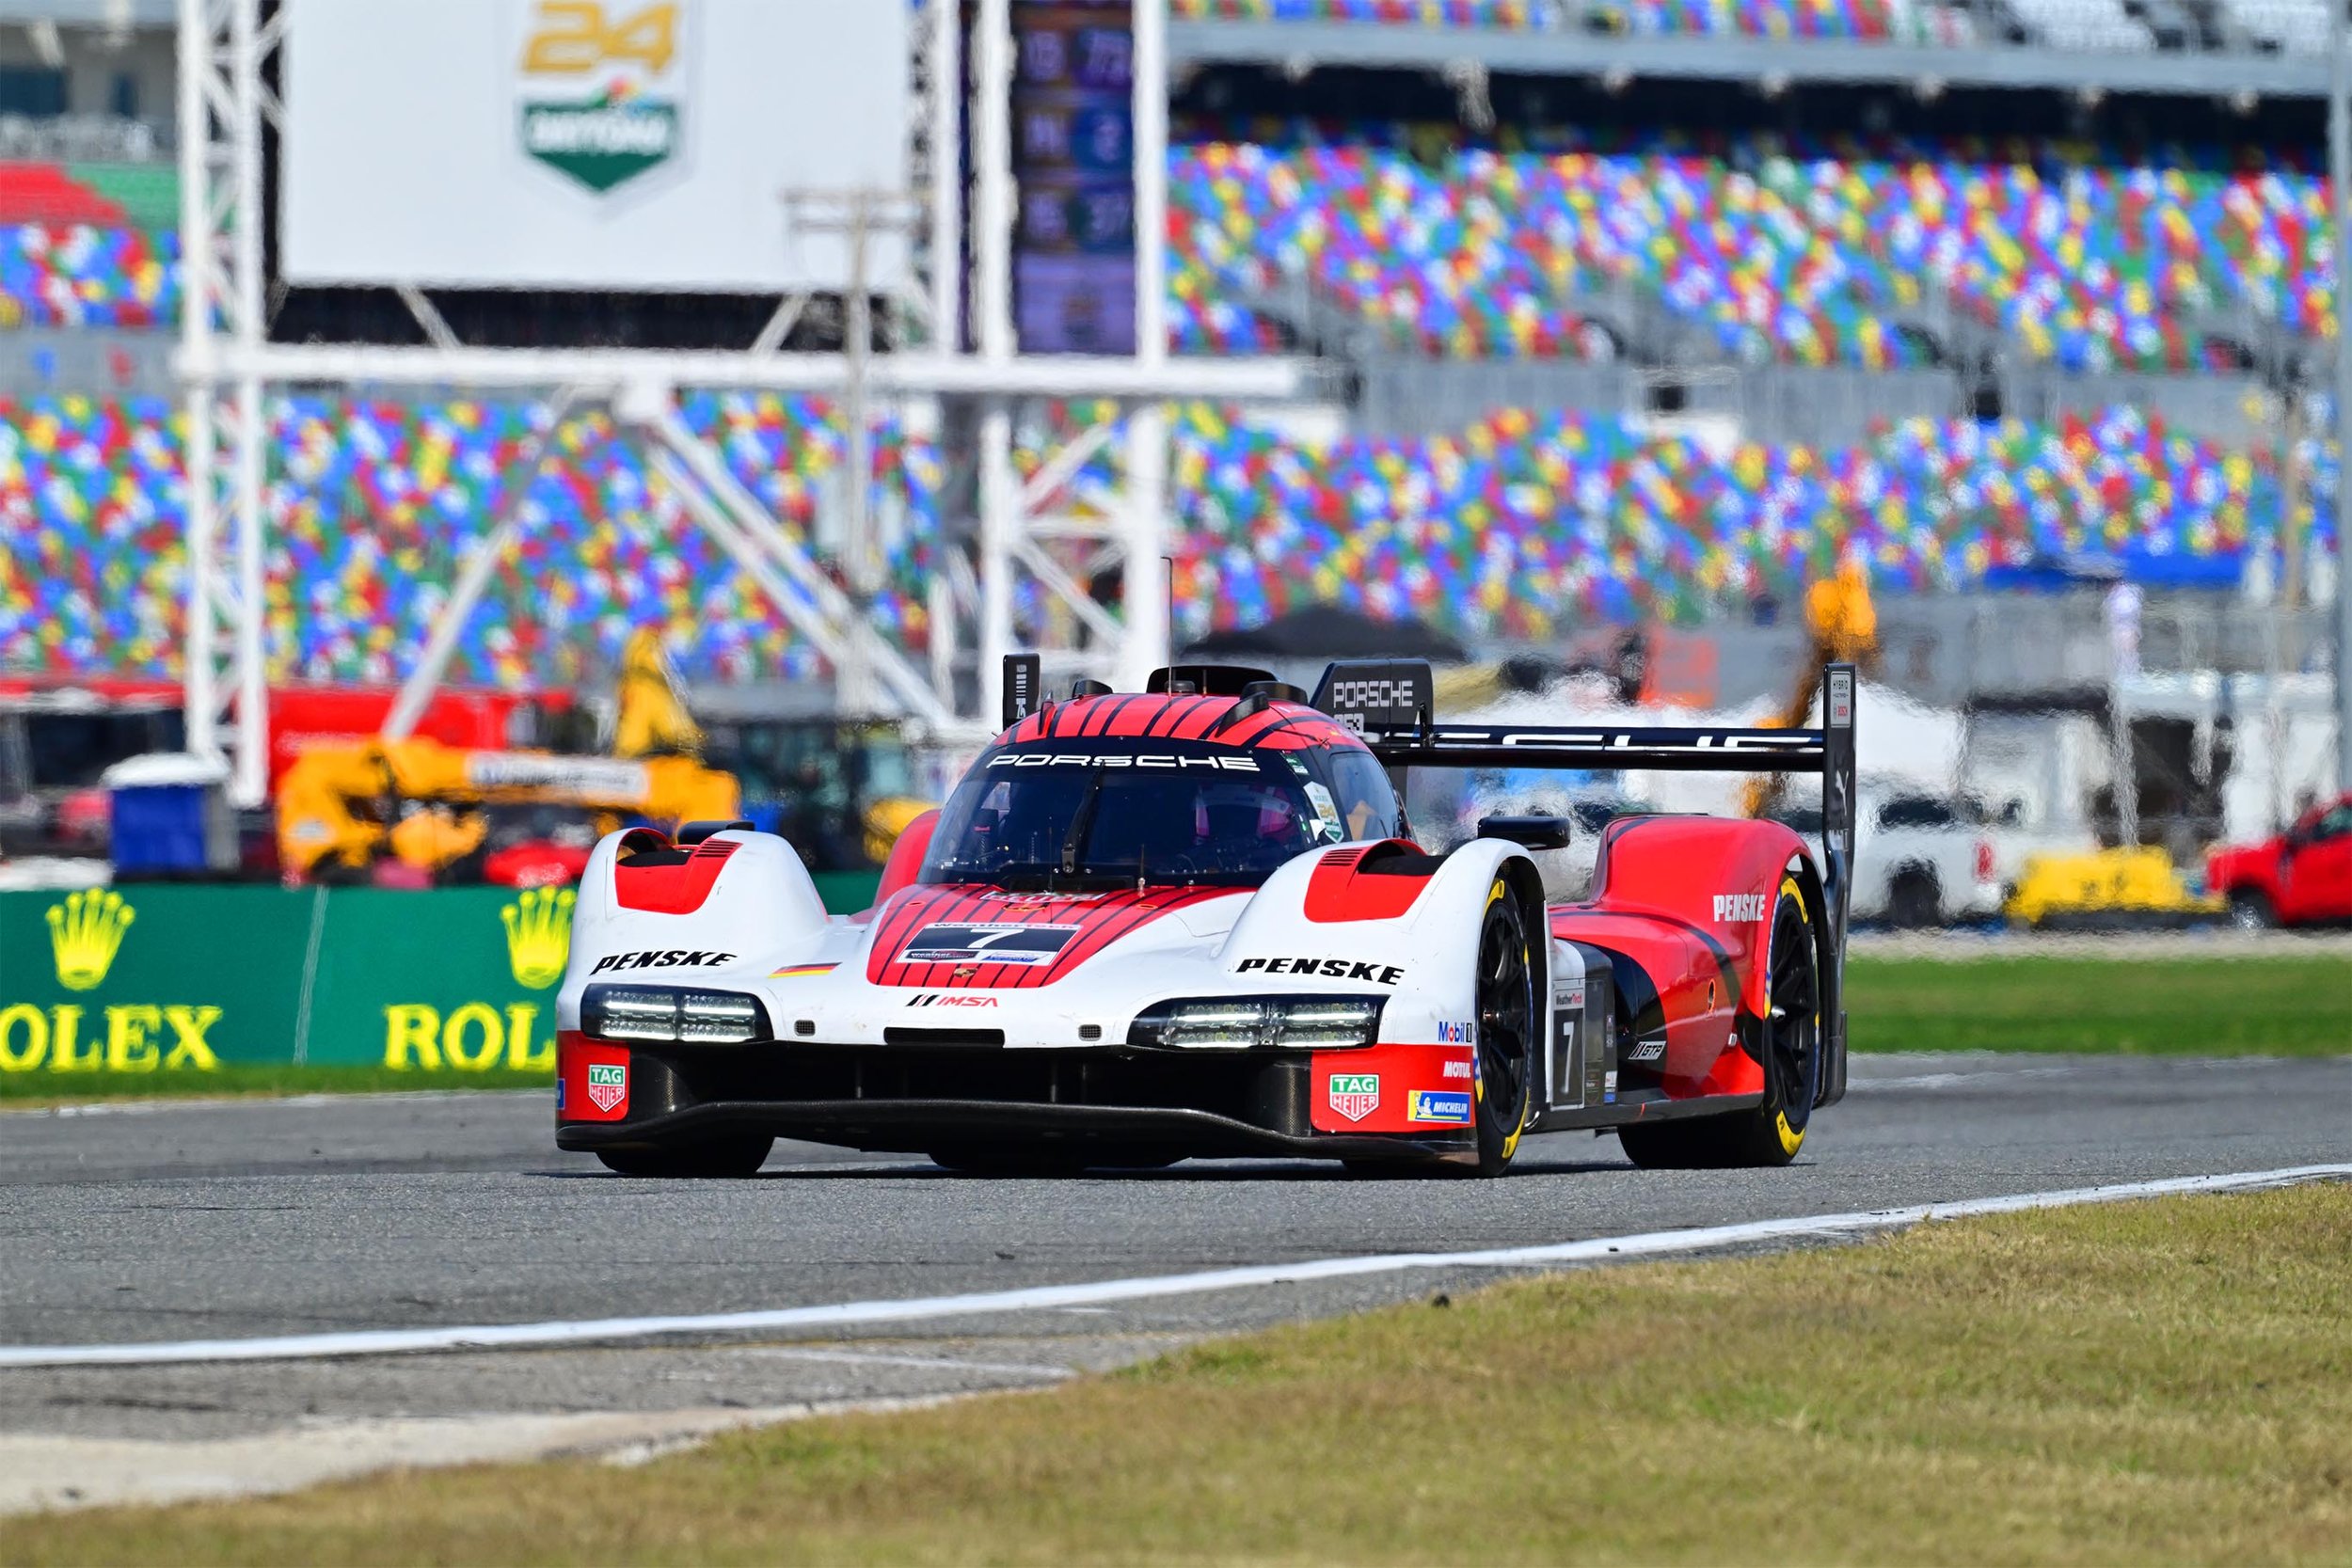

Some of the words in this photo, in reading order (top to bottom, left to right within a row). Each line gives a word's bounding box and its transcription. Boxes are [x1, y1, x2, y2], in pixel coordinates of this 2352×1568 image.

[520, 0, 676, 72] 24
[1333, 680, 1413, 708] PORSCHE
[986, 753, 1261, 771] PORSCHE
[1713, 894, 1766, 922] PENSKE
[967, 928, 1025, 949] 7
[589, 950, 738, 976] PENSKE
[1235, 958, 1405, 986] PENSKE
[936, 996, 998, 1007] IMSA
[0, 1003, 224, 1072] OLEX
[384, 1002, 556, 1071] ROL
[1438, 1022, 1465, 1042] Mobil
[1466, 1022, 1472, 1042] 1
[1563, 1021, 1575, 1095] 7
[1641, 1044, 1662, 1056] GTP
[592, 1068, 622, 1084] TAG
[1443, 1061, 1470, 1078] MOTUL
[1334, 1078, 1375, 1092] TAG
[591, 1086, 623, 1108] HEUER
[1332, 1095, 1376, 1117] HEUER
[1433, 1101, 1467, 1114] MICHELIN
